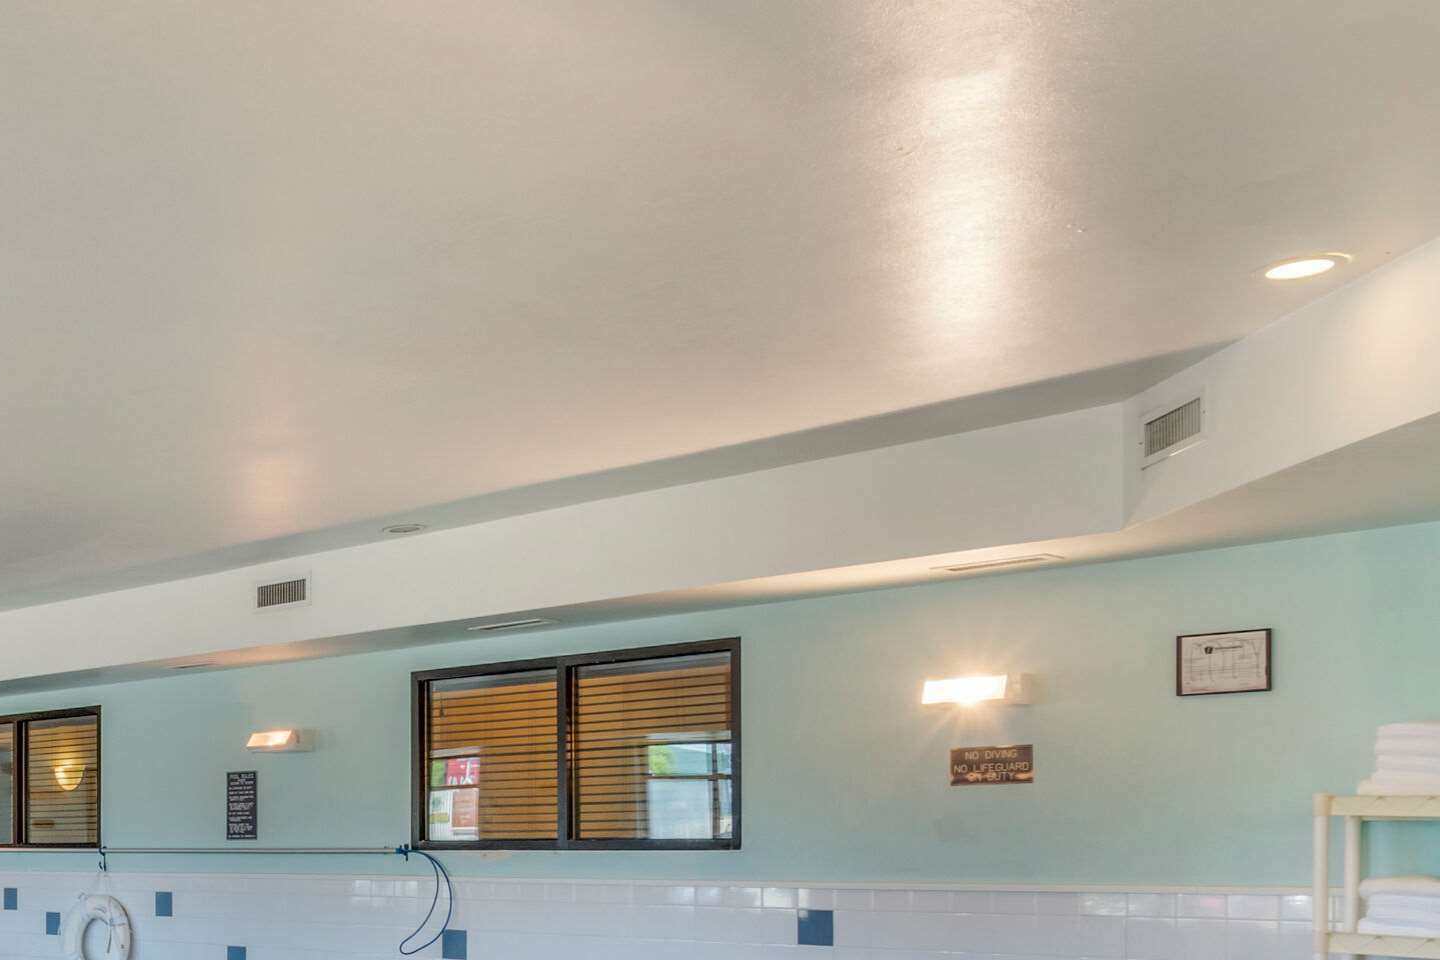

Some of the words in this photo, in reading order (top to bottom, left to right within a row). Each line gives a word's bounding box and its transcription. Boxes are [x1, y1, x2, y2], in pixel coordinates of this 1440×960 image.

[965, 751, 980, 761] NO
[985, 749, 1018, 760] DIVING
[954, 764, 969, 774] NO
[973, 761, 1030, 773] LIFEGUARD
